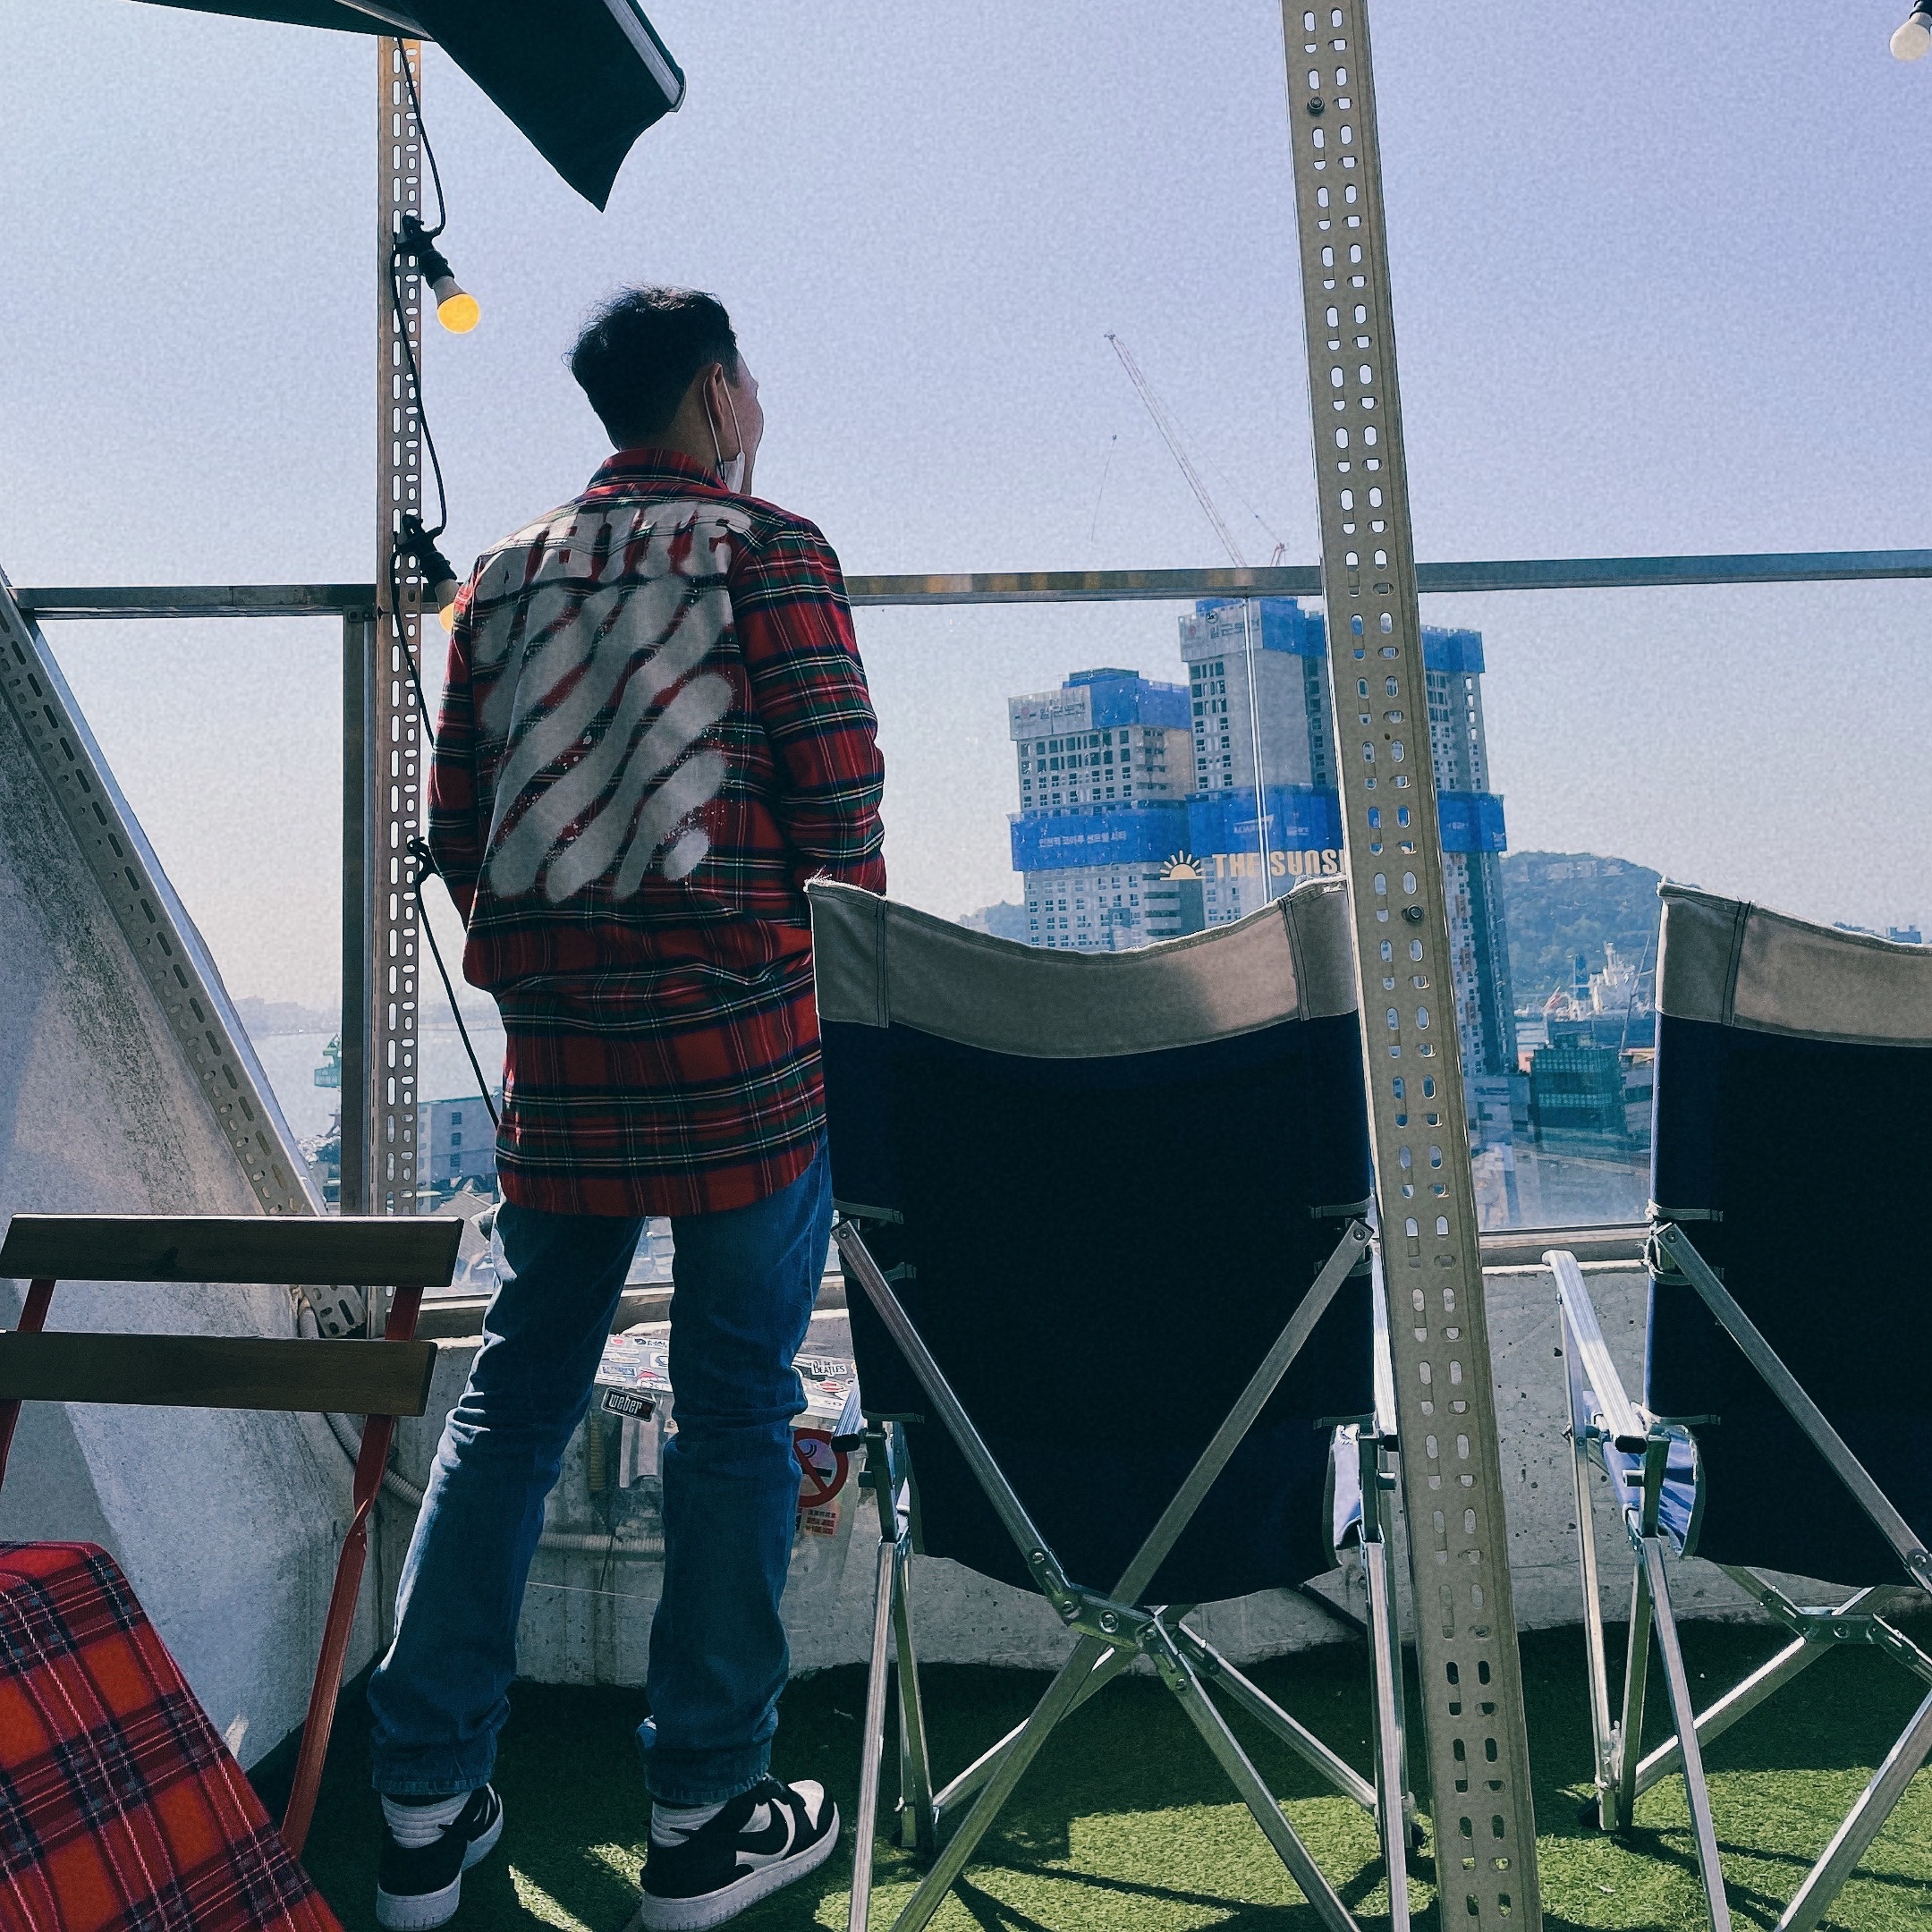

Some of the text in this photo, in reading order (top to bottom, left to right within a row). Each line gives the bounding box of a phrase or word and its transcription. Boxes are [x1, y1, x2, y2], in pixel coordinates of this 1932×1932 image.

[1212, 852, 1261, 878] THE
[812, 1360, 845, 1376] BEATLES
[608, 1393, 642, 1414] weber
